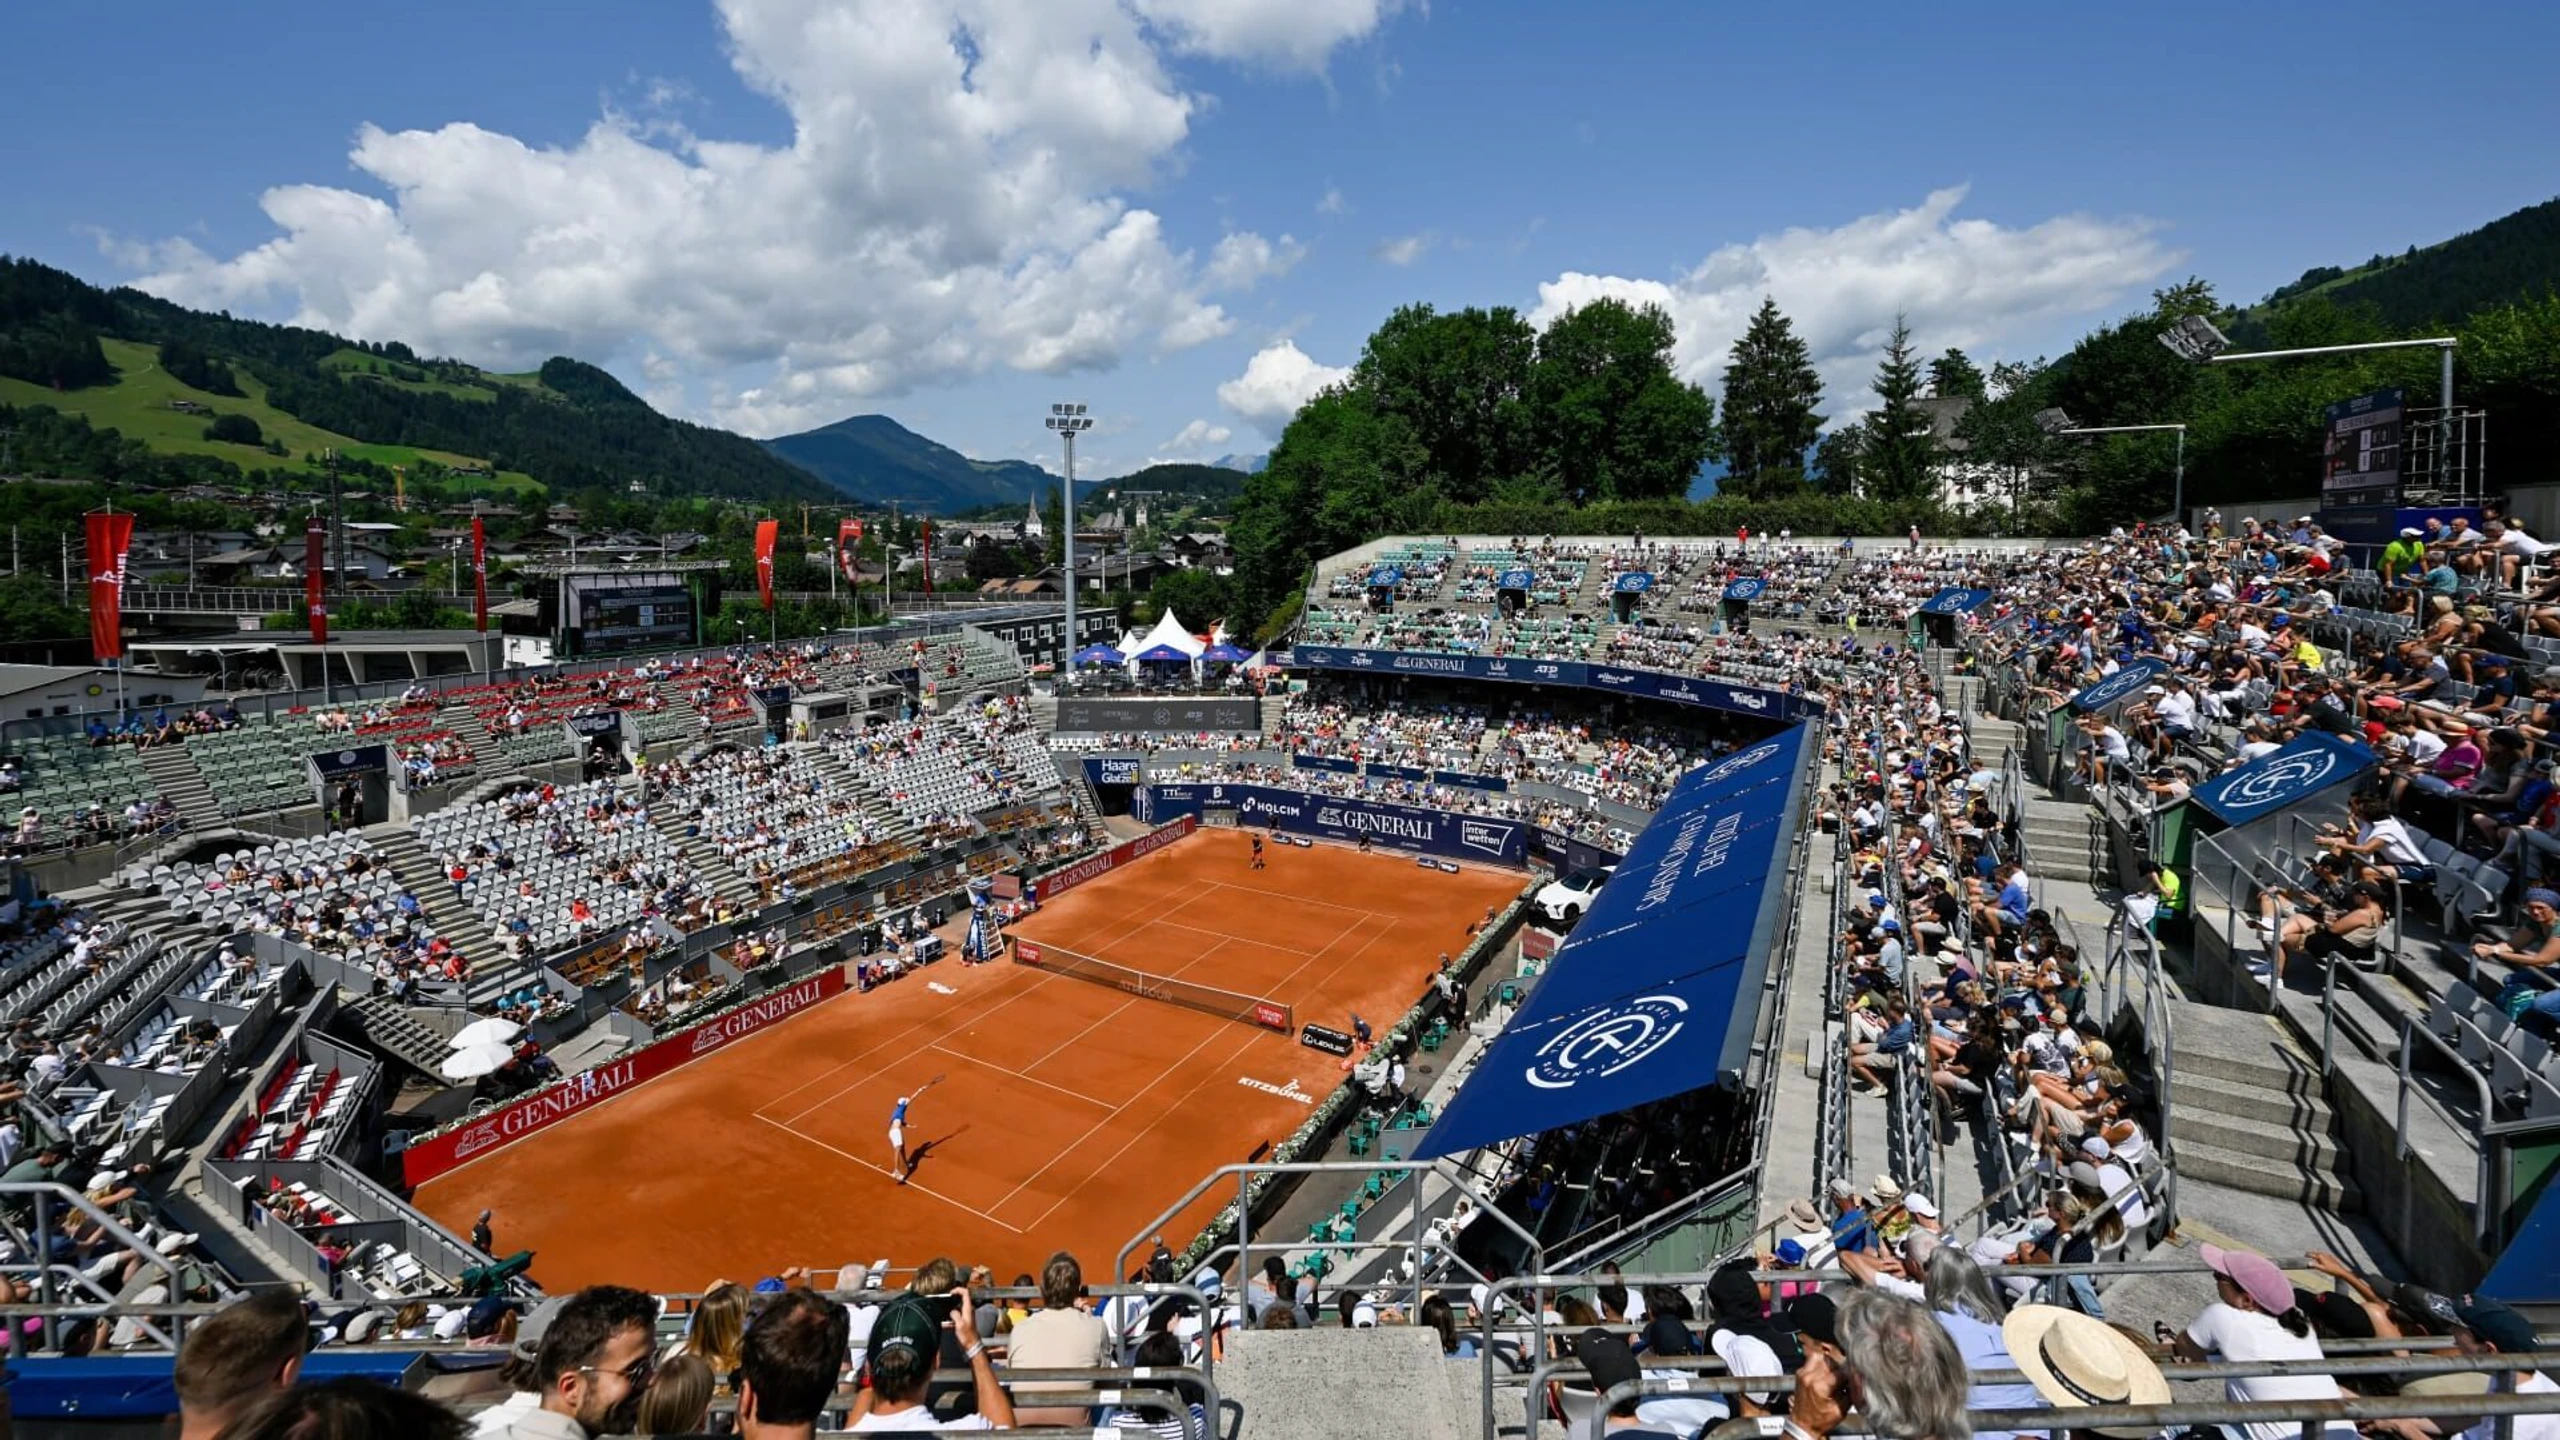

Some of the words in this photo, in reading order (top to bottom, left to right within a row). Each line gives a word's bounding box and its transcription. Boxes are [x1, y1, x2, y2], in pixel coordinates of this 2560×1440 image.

[1410, 656, 1465, 672] GENERALI
[1729, 686, 1767, 710] Tirol
[1101, 759, 1138, 771] Haare
[1257, 801, 1300, 817] HOLCIM
[1147, 823, 1186, 850] GENERALI
[1343, 810, 1433, 841] GENERALI
[1466, 822, 1489, 836] inter
[1467, 834, 1500, 846] wetten
[1063, 854, 1113, 886] GENERALI
[725, 980, 822, 1037] GENERALI
[502, 1060, 637, 1135] GENERALI
